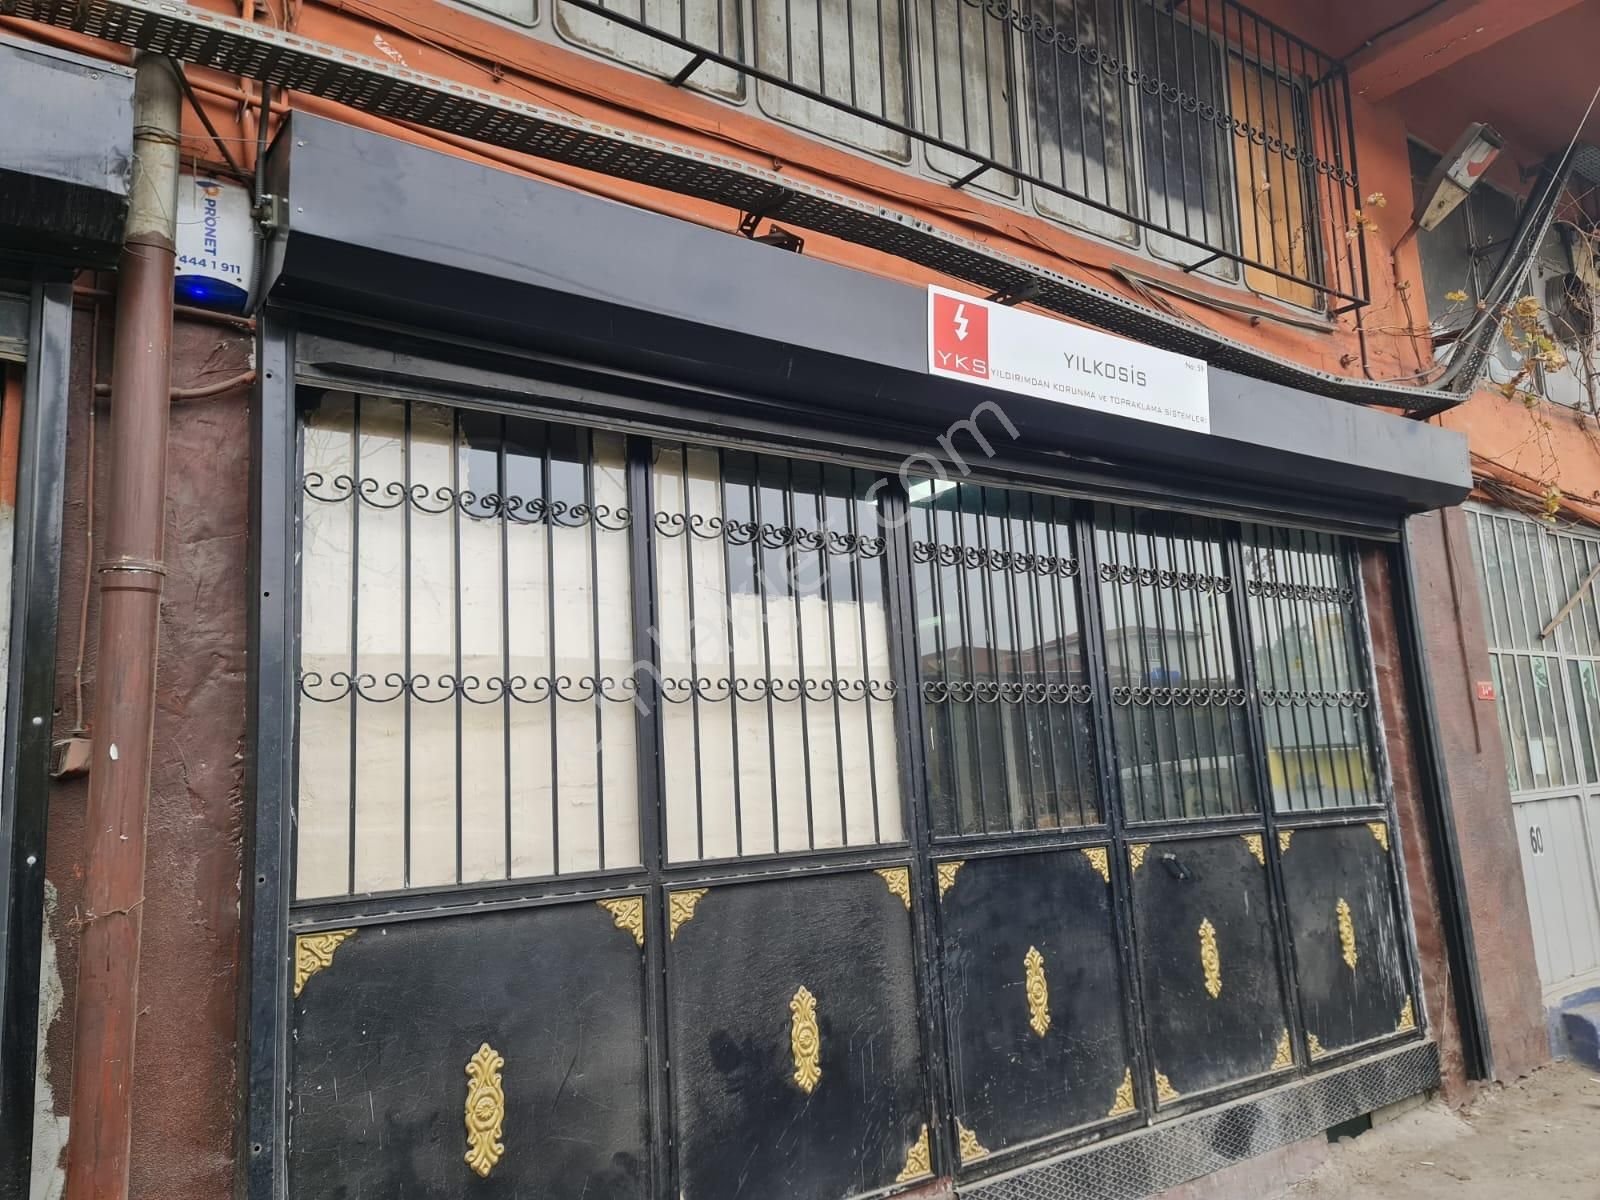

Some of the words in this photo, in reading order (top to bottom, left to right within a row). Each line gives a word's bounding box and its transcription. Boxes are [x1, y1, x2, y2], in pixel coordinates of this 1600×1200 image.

[204, 199, 216, 256] PRONET
[179, 255, 206, 267] 444
[211, 261, 216, 269] 1
[221, 263, 240, 274] 911
[938, 350, 986, 374] YKS
[1063, 352, 1147, 387] YILKOSİS
[991, 368, 1050, 389] YILDIRIMDAN
[1053, 383, 1096, 400] KORUNMA
[1110, 395, 1162, 414] TOPRAKLAMA
[1530, 826, 1543, 853] 60
